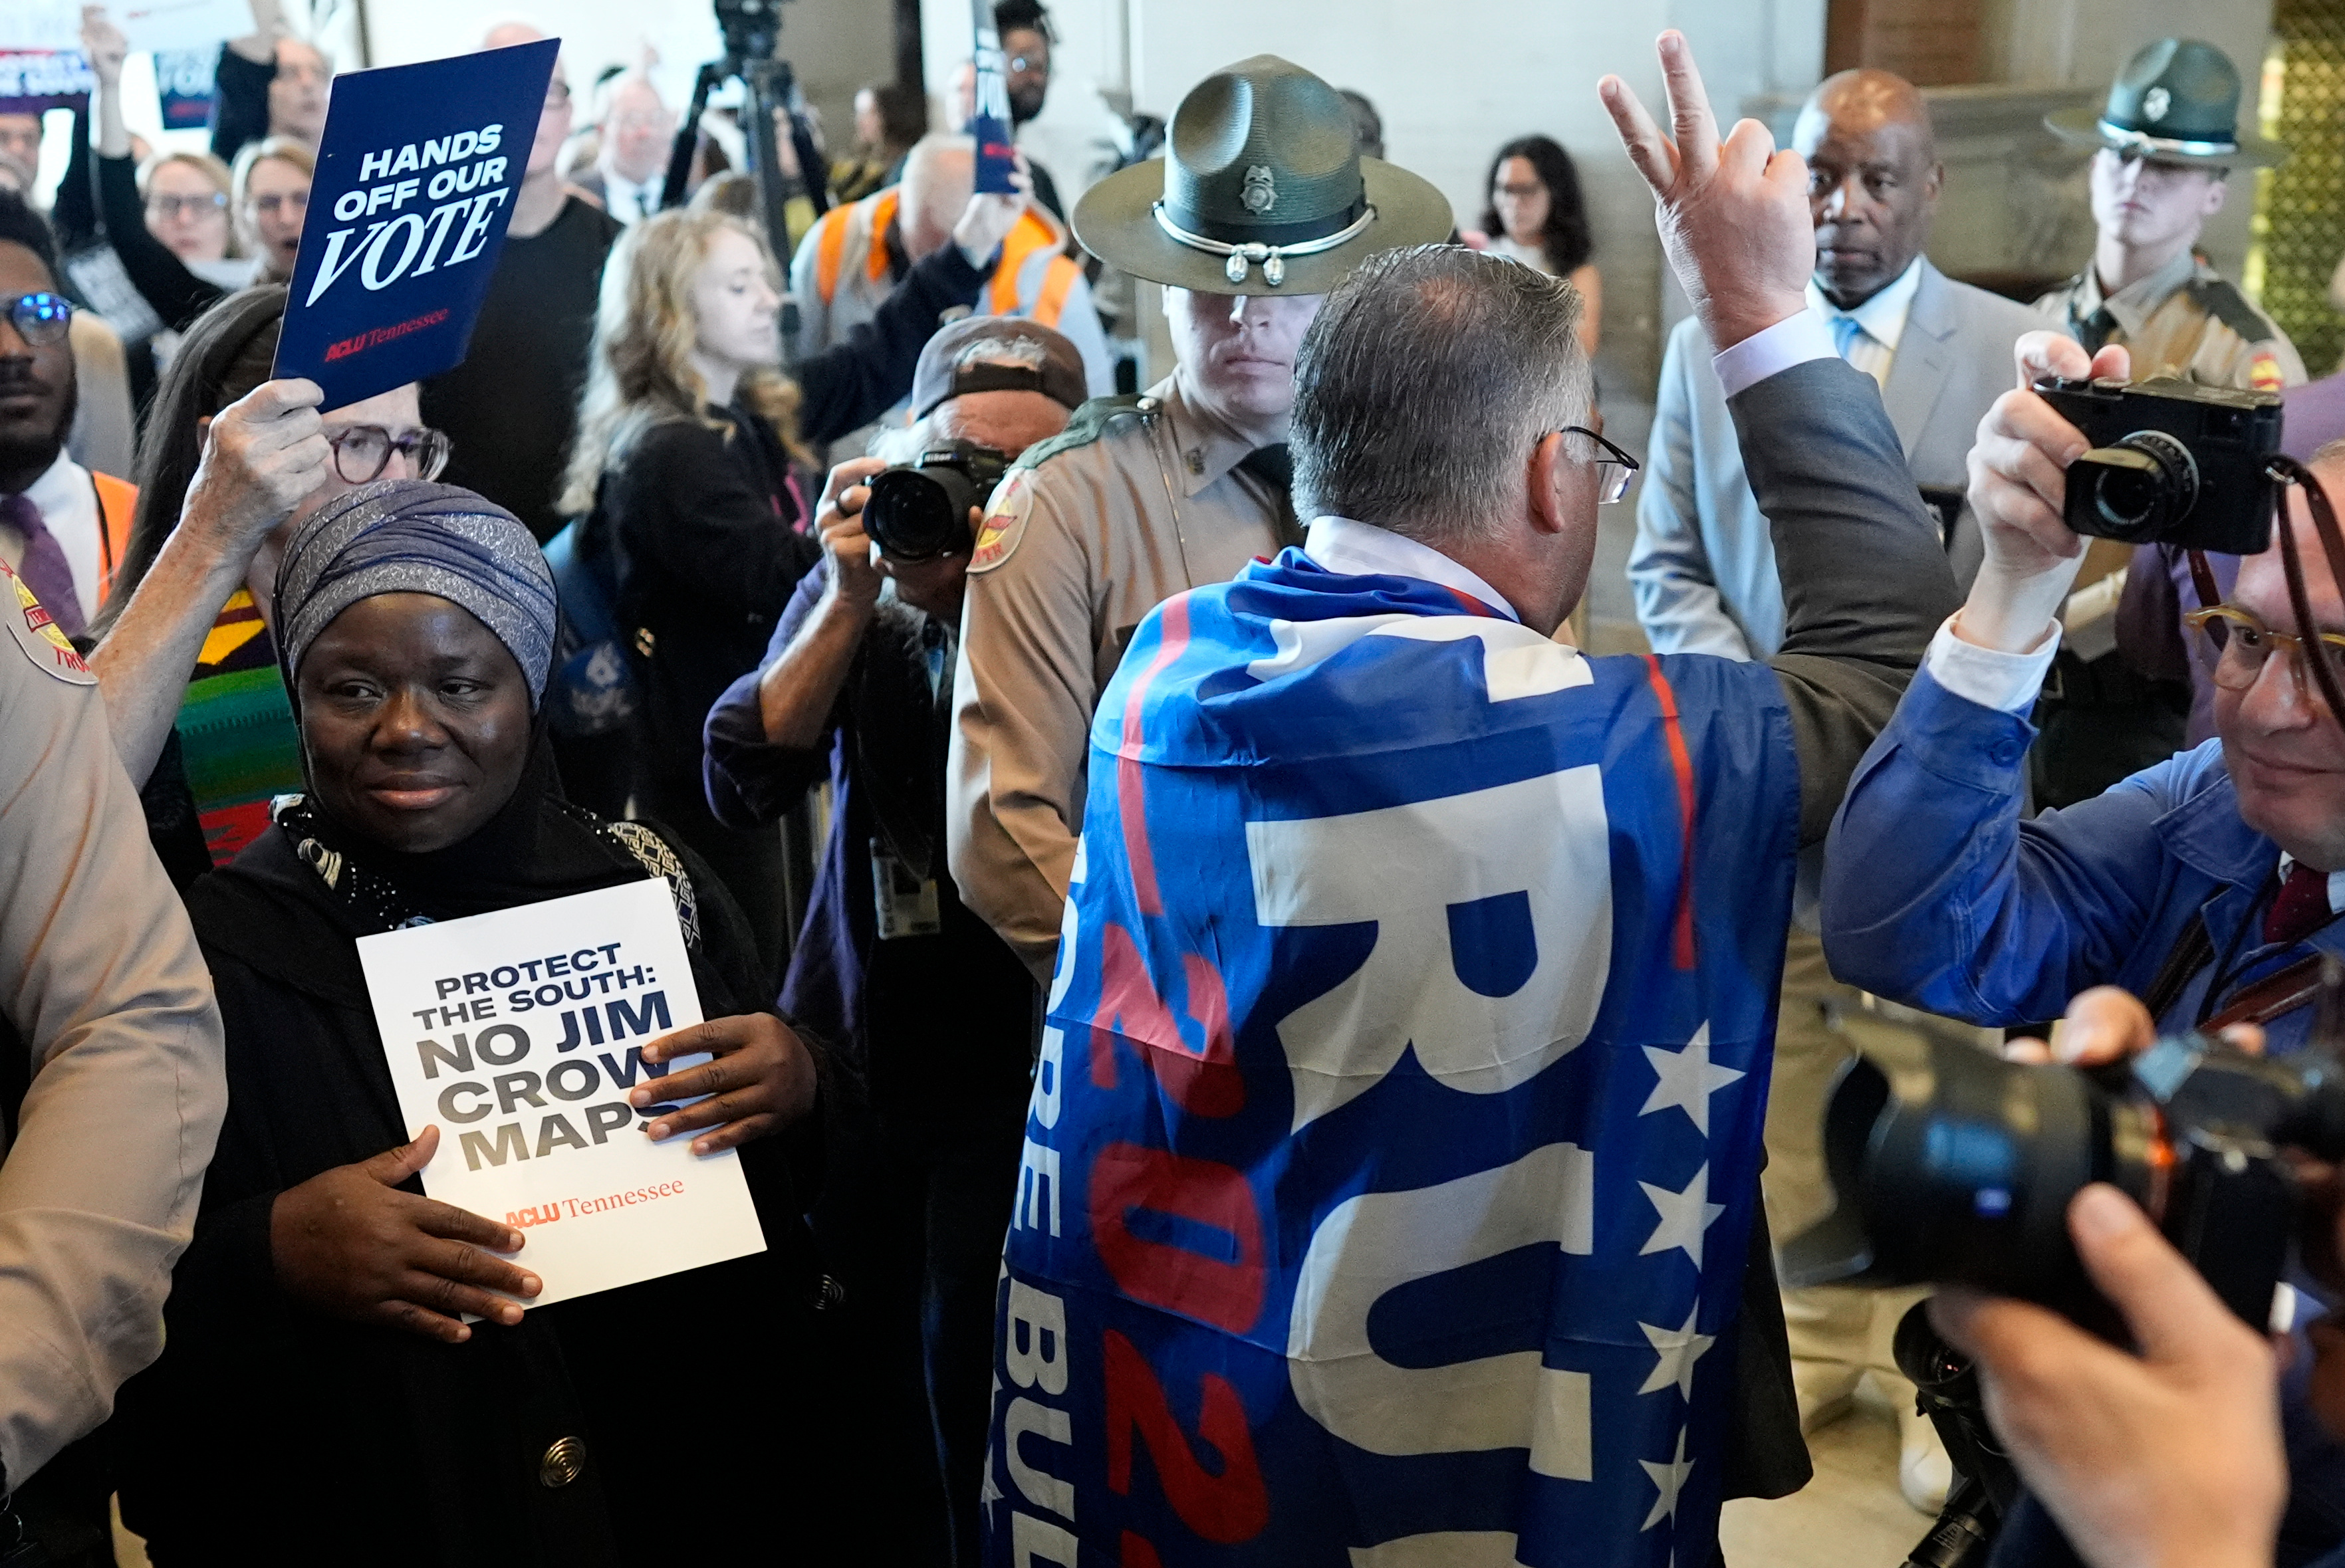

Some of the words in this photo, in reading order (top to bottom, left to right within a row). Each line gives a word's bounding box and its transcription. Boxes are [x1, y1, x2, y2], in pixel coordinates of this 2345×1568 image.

[359, 124, 503, 182] HANDS
[334, 177, 420, 221] OFF
[428, 156, 507, 200] OUR
[305, 187, 509, 308] VOTE
[324, 336, 365, 362] ACLU
[368, 308, 449, 346] Tennessee
[412, 996, 497, 1031] THE
[509, 966, 656, 1012] SOUTH:
[434, 943, 621, 1000] PROTECT
[416, 1023, 531, 1079] NO
[556, 990, 673, 1054] JIM
[437, 1045, 672, 1124] CROW
[1245, 613, 1613, 1567] TRU
[505, 1202, 560, 1230] ACLU
[562, 1178, 685, 1218] Tennessee
[1089, 923, 1271, 1567] 202
